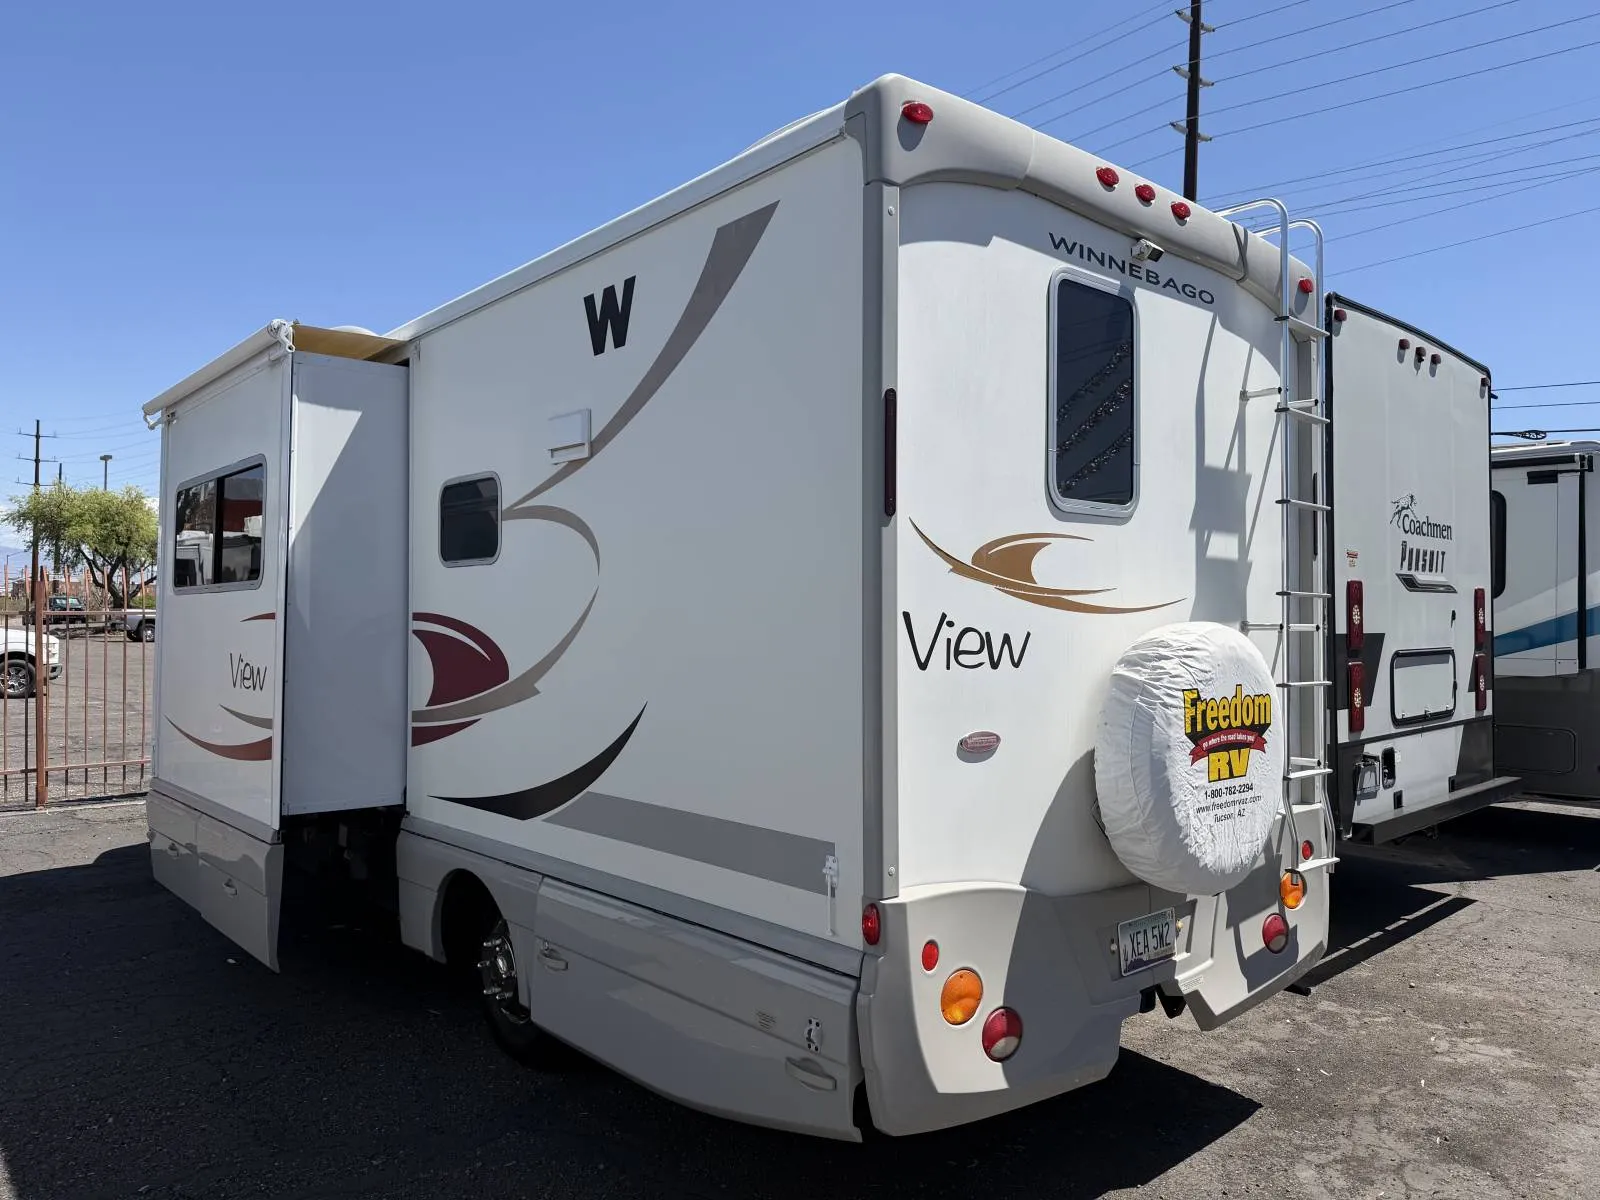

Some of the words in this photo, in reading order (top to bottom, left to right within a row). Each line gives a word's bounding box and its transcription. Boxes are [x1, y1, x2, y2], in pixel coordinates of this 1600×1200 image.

[1048, 231, 1215, 305] WINNEBAGO
[583, 275, 637, 357] W
[1402, 513, 1452, 540] Coachmen
[1400, 540, 1446, 573] PURSUIT
[902, 610, 1032, 671] View
[229, 652, 267, 692] View
[1182, 684, 1272, 735] Freedom
[1208, 747, 1251, 783] RV
[1204, 782, 1254, 801] 1-800-782-2294
[1236, 808, 1246, 818] AZ
[1129, 928, 1150, 959] XEA
